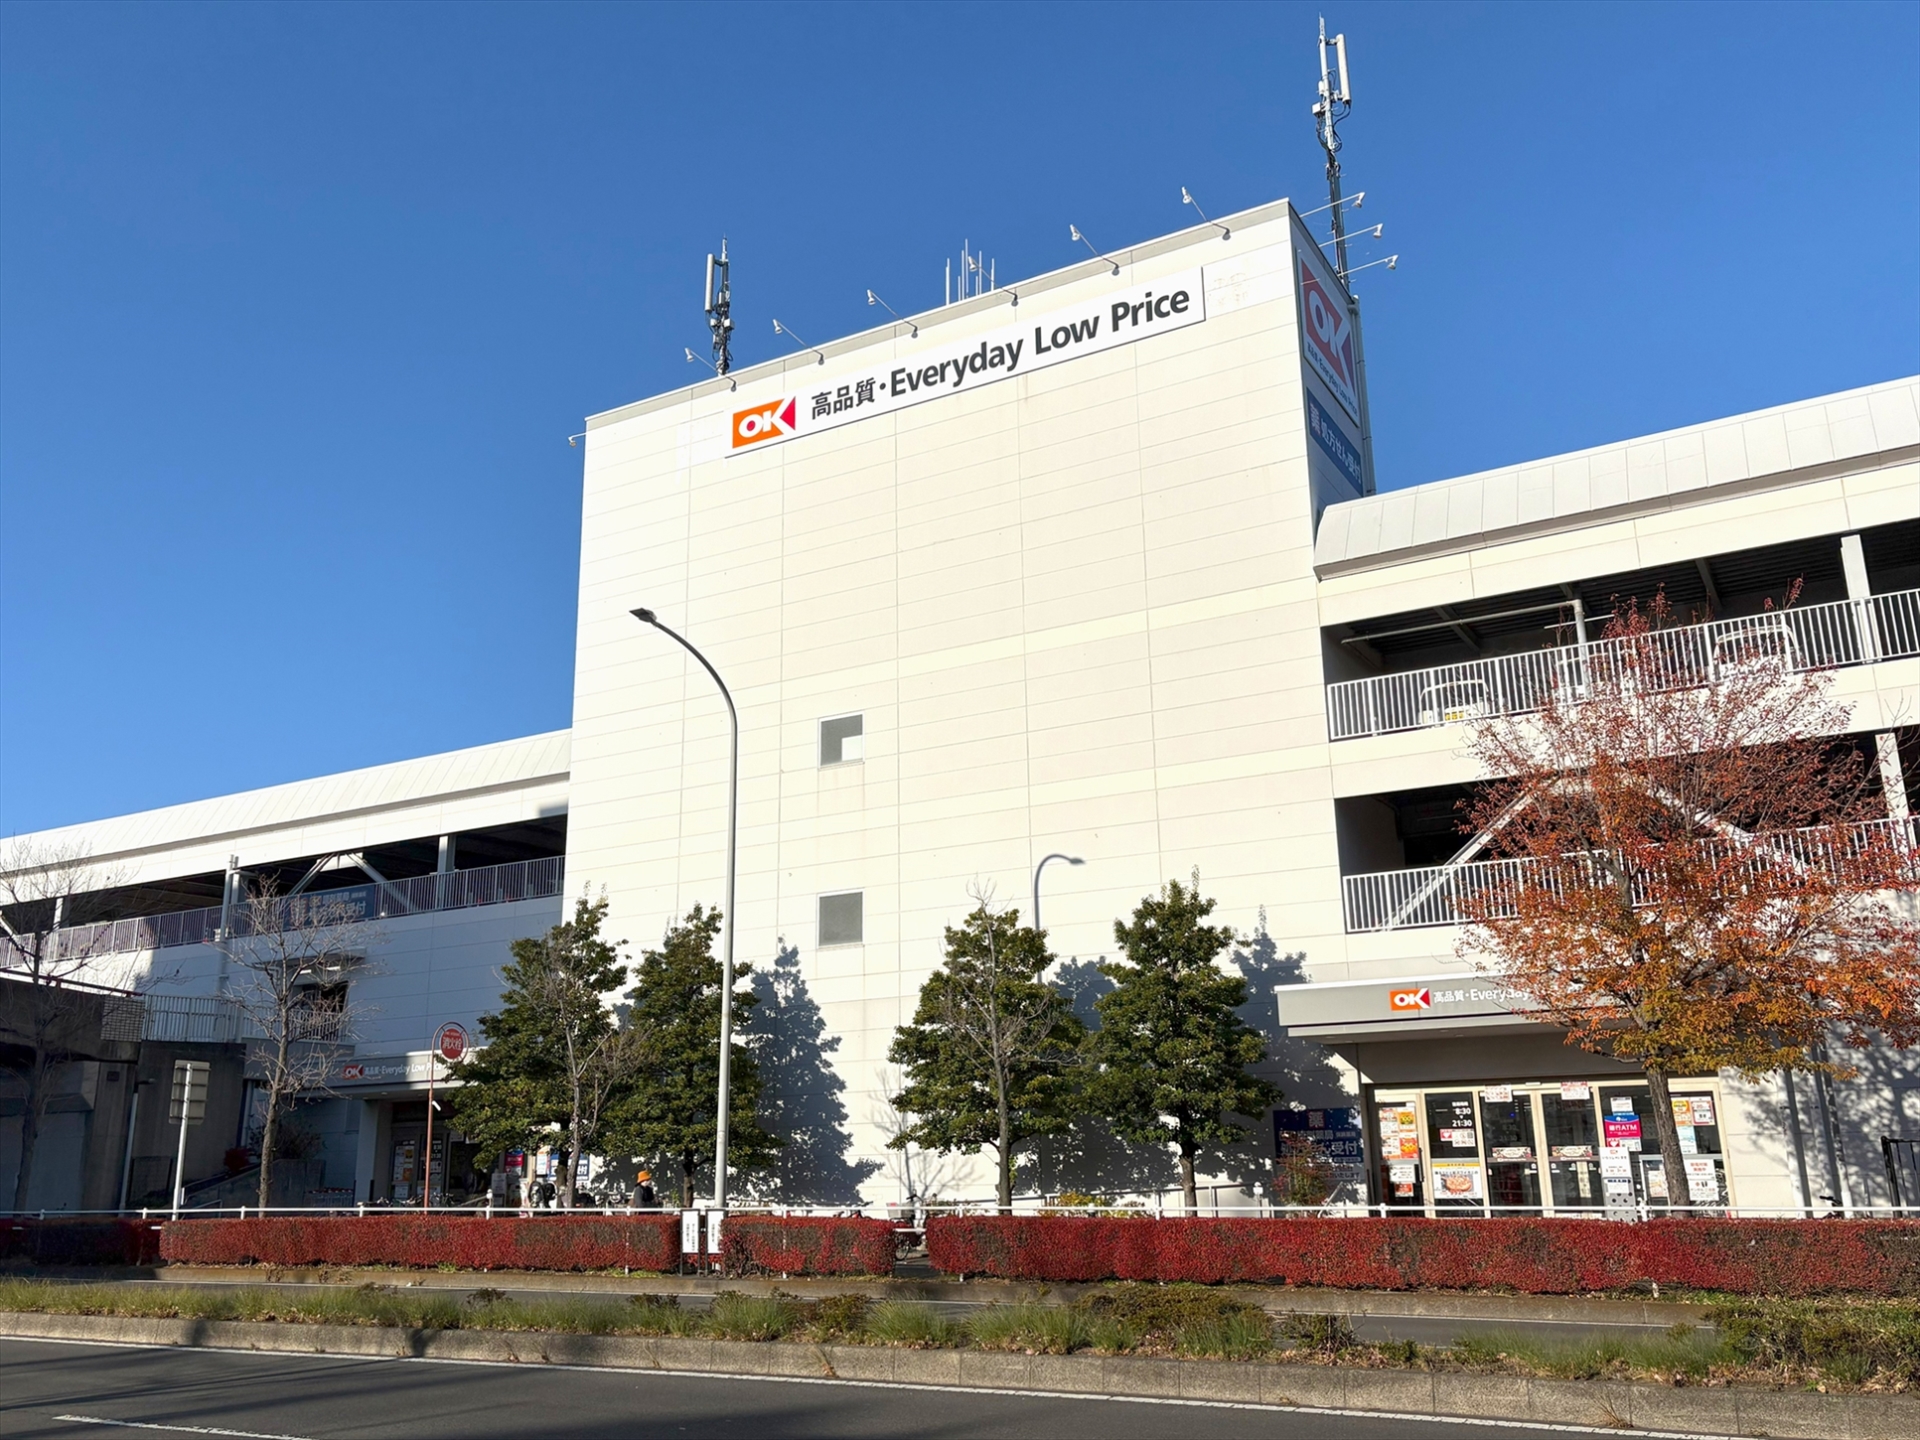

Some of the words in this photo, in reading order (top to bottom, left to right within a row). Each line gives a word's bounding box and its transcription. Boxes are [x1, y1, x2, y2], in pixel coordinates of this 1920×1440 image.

[1035, 315, 1100, 355] Low
[1111, 290, 1190, 333] Price
[738, 395, 796, 438] OK
[1394, 987, 1431, 1009] OK
[442, 1036, 463, 1051] 消火栓
[345, 1064, 363, 1077] OK
[411, 1063, 425, 1073] Low
[1455, 1107, 1472, 1115] 8:30
[1452, 1119, 1473, 1127] 21:30
